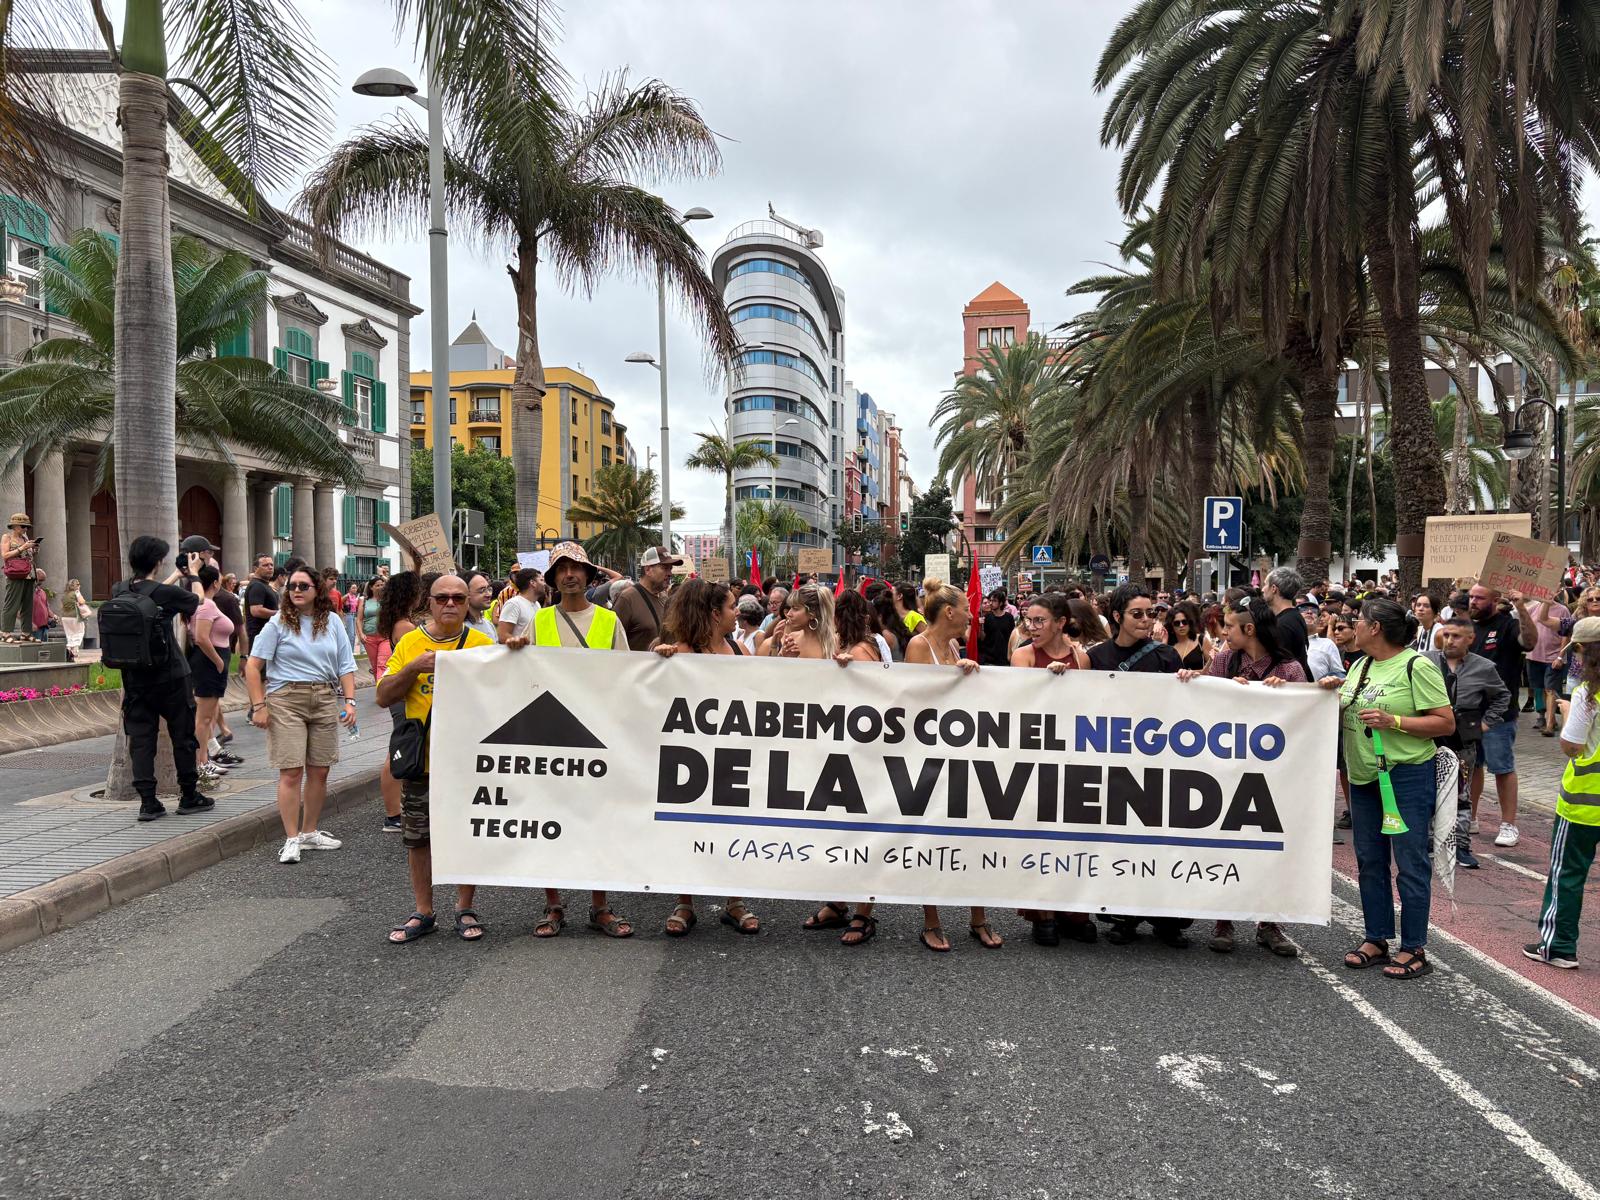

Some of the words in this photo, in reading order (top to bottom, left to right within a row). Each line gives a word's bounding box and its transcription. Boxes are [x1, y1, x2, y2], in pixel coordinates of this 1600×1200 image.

[1213, 501, 1234, 528] P
[1496, 533, 1511, 543] LOS
[1507, 563, 1523, 573] SON
[662, 697, 906, 744] ACABEMOS
[913, 708, 1010, 749] CON
[1019, 712, 1066, 751] EL
[1075, 715, 1286, 762] NEGOCIO
[475, 754, 608, 778] DERECHO
[472, 786, 508, 805] AL
[657, 745, 752, 807] DE
[767, 750, 868, 814] LA
[883, 755, 1284, 833] VIVIENDA
[470, 818, 562, 840] TECHO
[694, 840, 714, 855] NI
[728, 838, 815, 863] CASAS
[825, 845, 869, 865] SIN
[883, 846, 967, 872] GENTE,
[982, 851, 1007, 870] NI
[1021, 852, 1100, 878] GENTE
[1111, 859, 1156, 878] SIN
[1171, 860, 1240, 885] CASA
